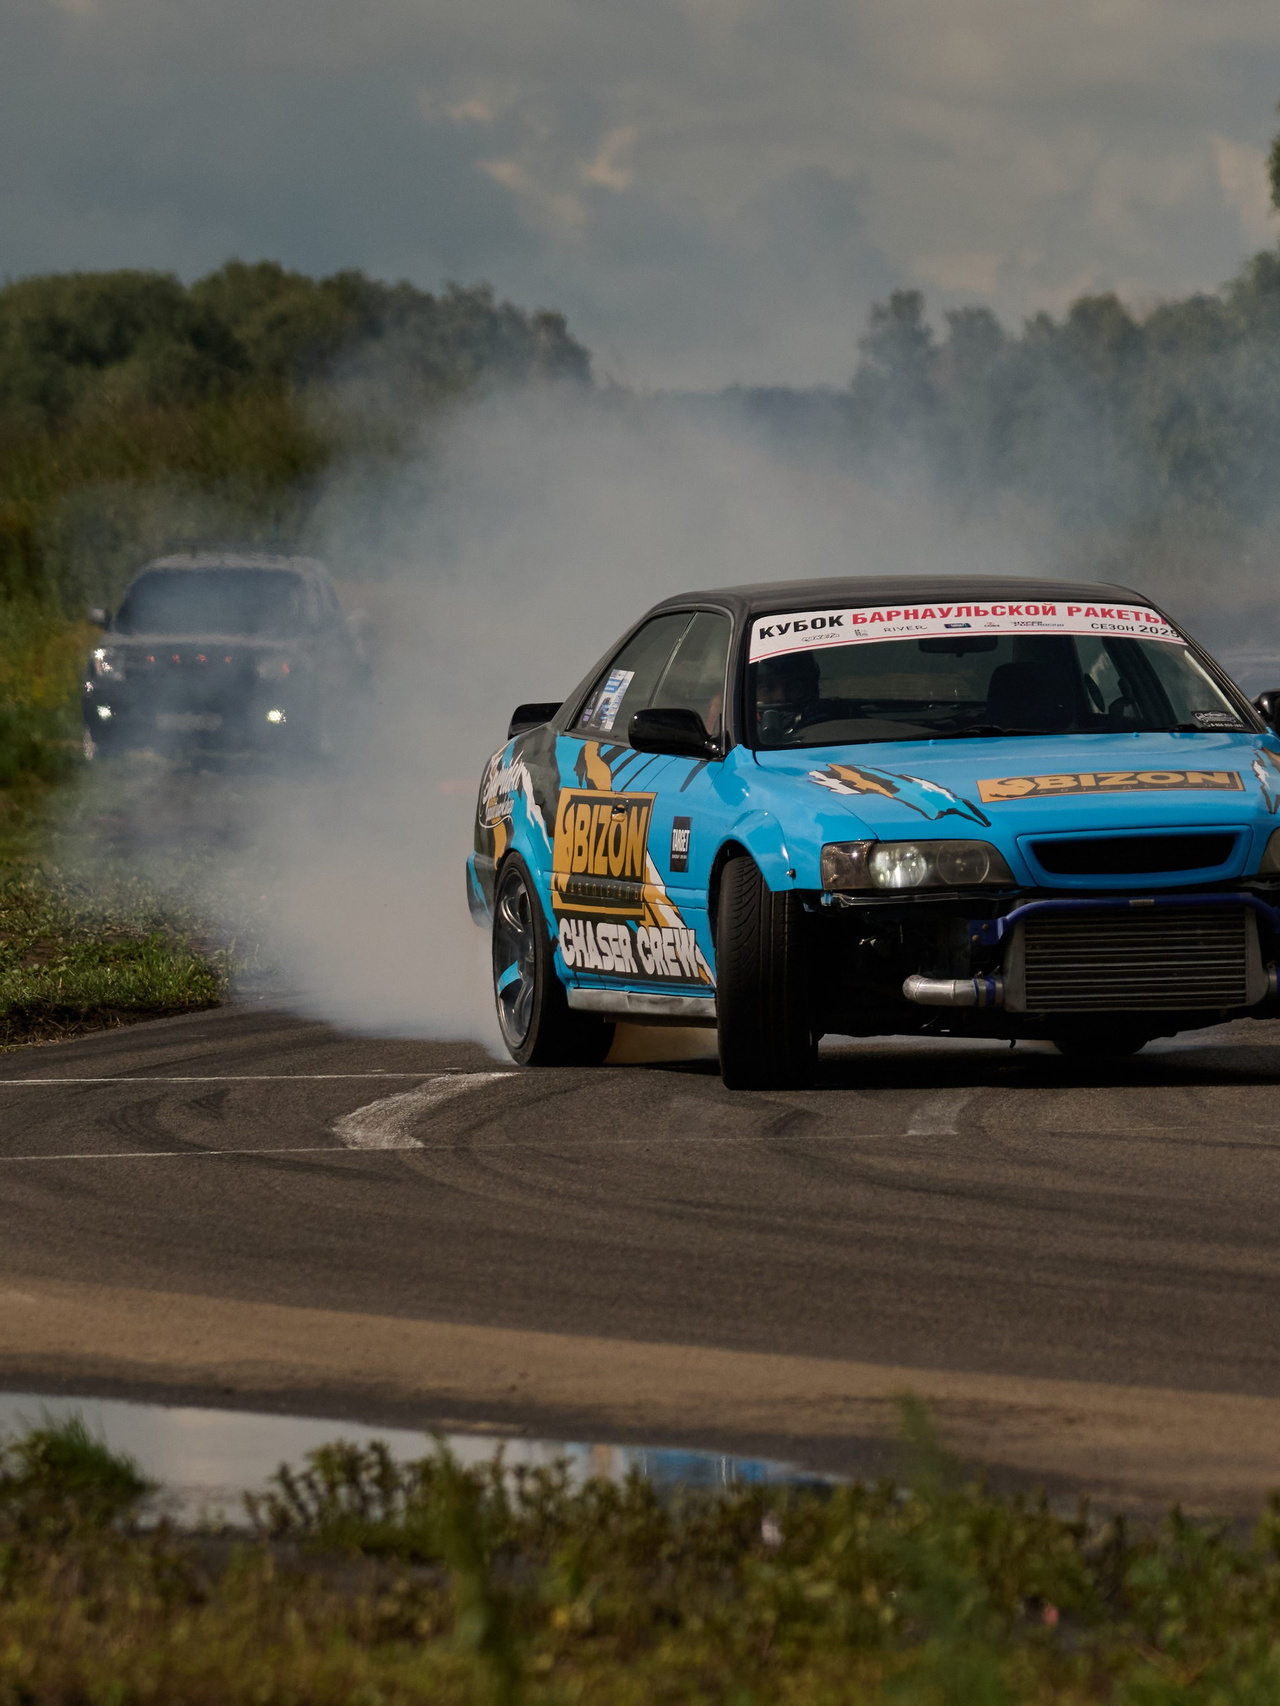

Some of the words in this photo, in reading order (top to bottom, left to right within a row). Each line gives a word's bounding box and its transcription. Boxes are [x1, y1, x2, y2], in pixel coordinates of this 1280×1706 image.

[759, 615, 844, 640] КУБОК
[852, 602, 1058, 625] БАРНАУЛЬСКОЙ
[1068, 606, 1170, 625] РАКЕТЫ
[1091, 622, 1134, 632] СЕЗОН
[1139, 625, 1181, 638] 2025
[1031, 771, 1232, 790] BIZON
[572, 803, 649, 878] BIZON
[559, 917, 638, 973] CHASER
[636, 926, 700, 977] CREW
